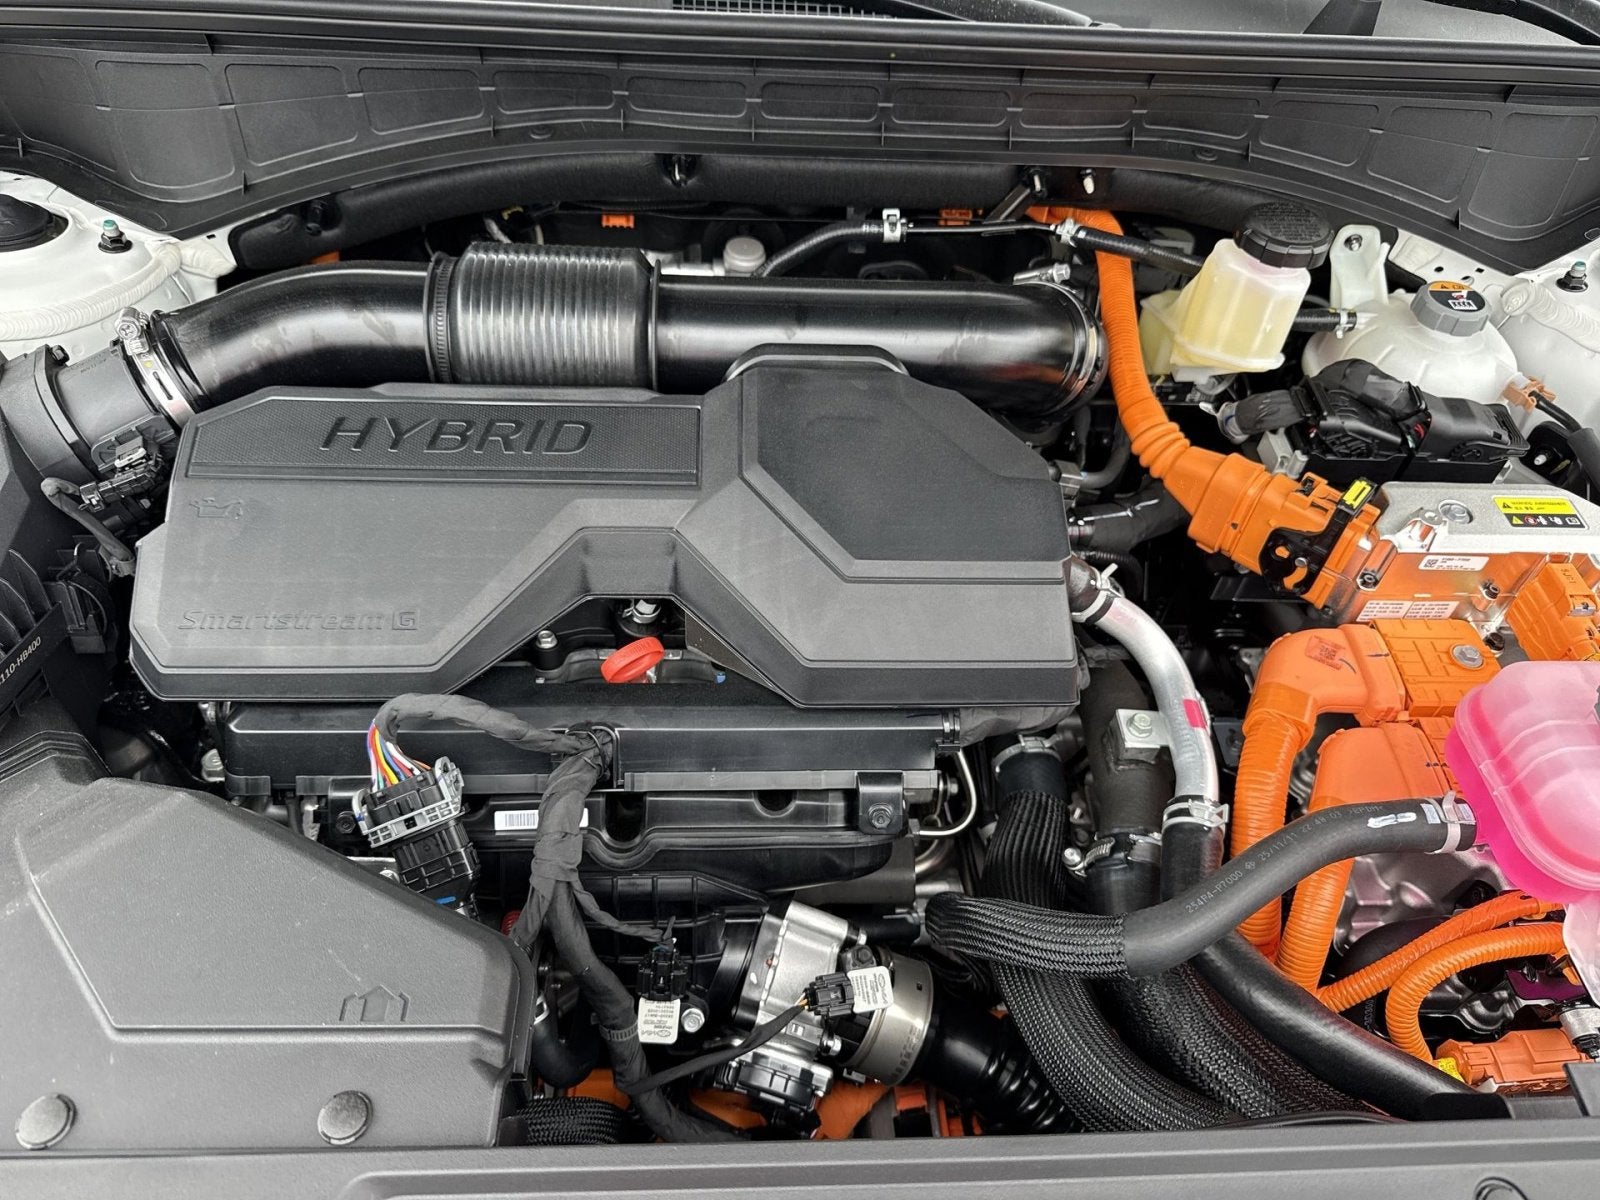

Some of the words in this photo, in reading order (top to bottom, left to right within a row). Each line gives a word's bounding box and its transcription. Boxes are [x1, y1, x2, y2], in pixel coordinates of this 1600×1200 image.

[319, 415, 593, 455] HYBRID
[177, 608, 385, 630] Smartstream
[395, 610, 417, 630] G
[0, 635, 42, 685] 110-HB400
[1260, 832, 1298, 862] 25/11/11
